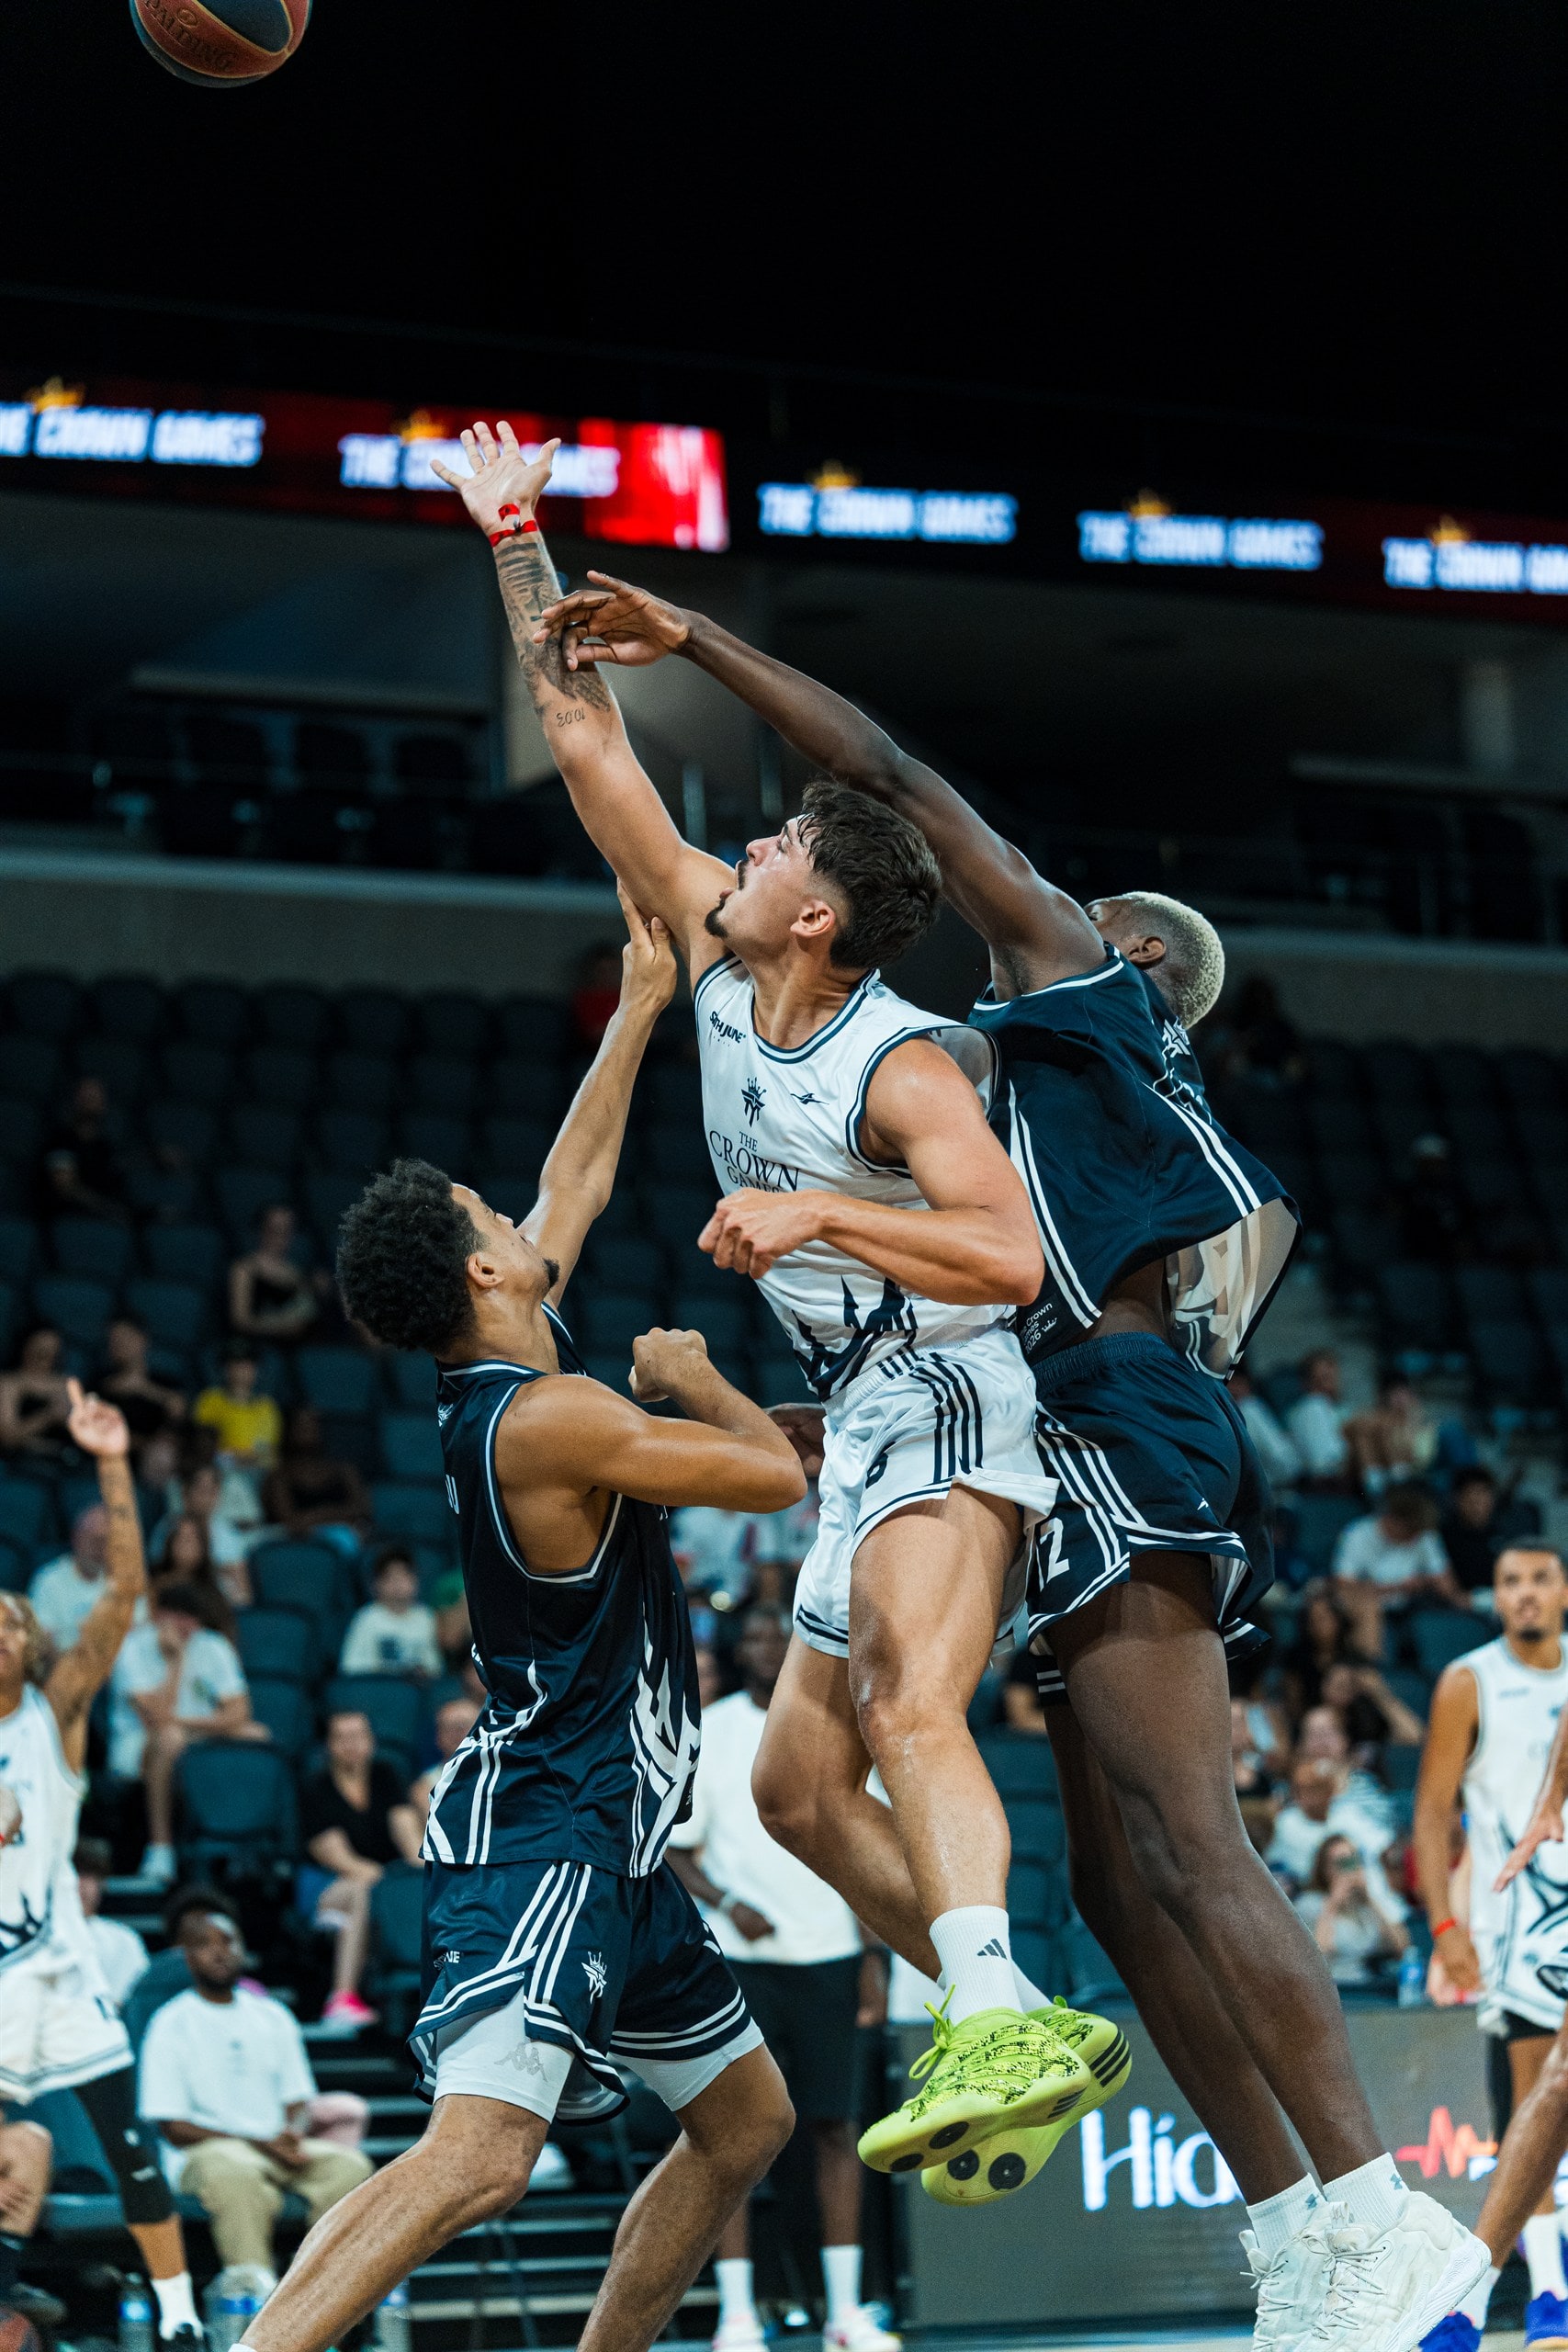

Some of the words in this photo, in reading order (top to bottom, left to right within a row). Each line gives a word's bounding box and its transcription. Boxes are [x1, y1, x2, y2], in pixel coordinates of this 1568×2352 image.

[140, 0, 237, 74] PALDING
[719, 1024, 741, 1044] JUNE
[709, 1130, 800, 1192] CROWN
[739, 1131, 758, 1152] THE
